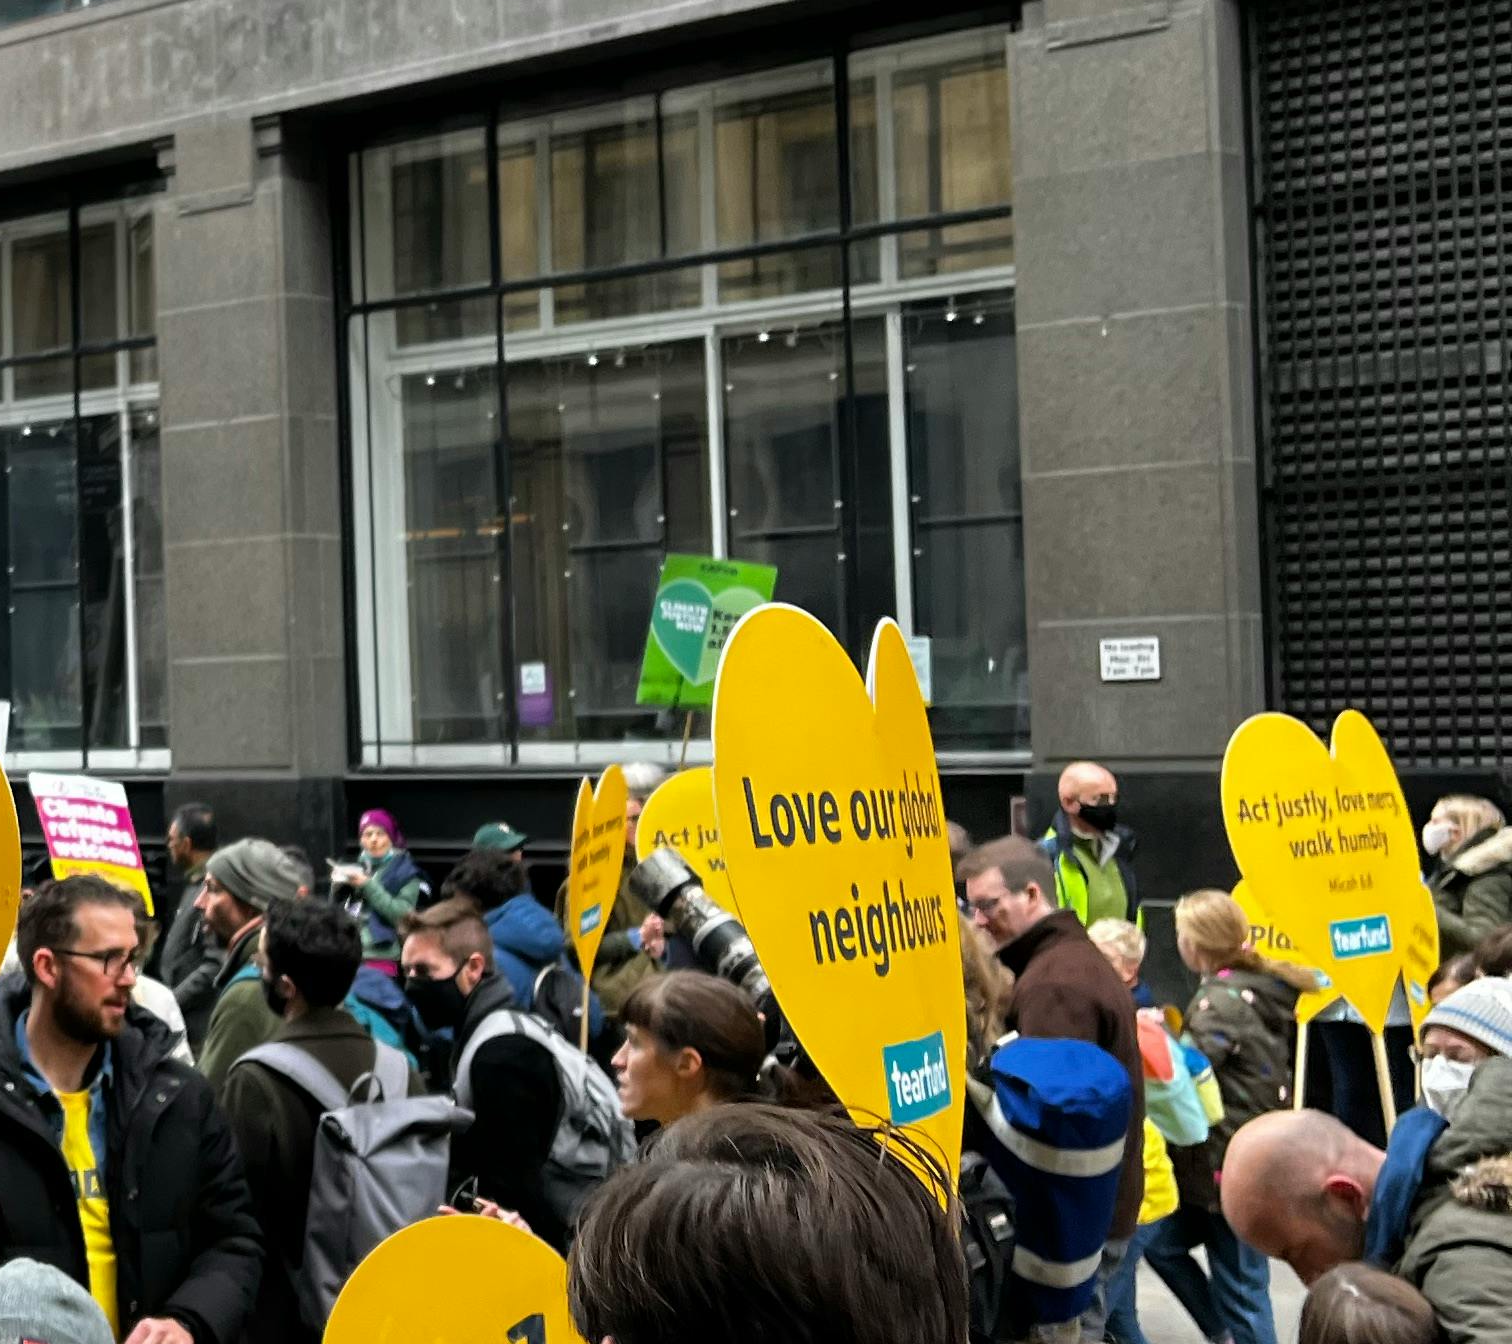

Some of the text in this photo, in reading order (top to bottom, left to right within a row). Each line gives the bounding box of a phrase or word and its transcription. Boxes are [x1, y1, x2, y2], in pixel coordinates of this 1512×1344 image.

[676, 618, 705, 633] NOW
[41, 798, 118, 826] Climate
[742, 768, 942, 859] Love our global
[1238, 795, 1271, 824] Act
[1273, 788, 1334, 828] justly,
[1335, 786, 1365, 813] love
[47, 820, 134, 848] refugees
[653, 826, 690, 848] Act
[1288, 825, 1389, 859] walk humbly
[52, 840, 138, 867] welcome
[809, 879, 948, 977] neighbours
[1249, 924, 1300, 952] Pla
[1333, 920, 1387, 953] tearfund
[890, 1046, 947, 1108] tearfund
